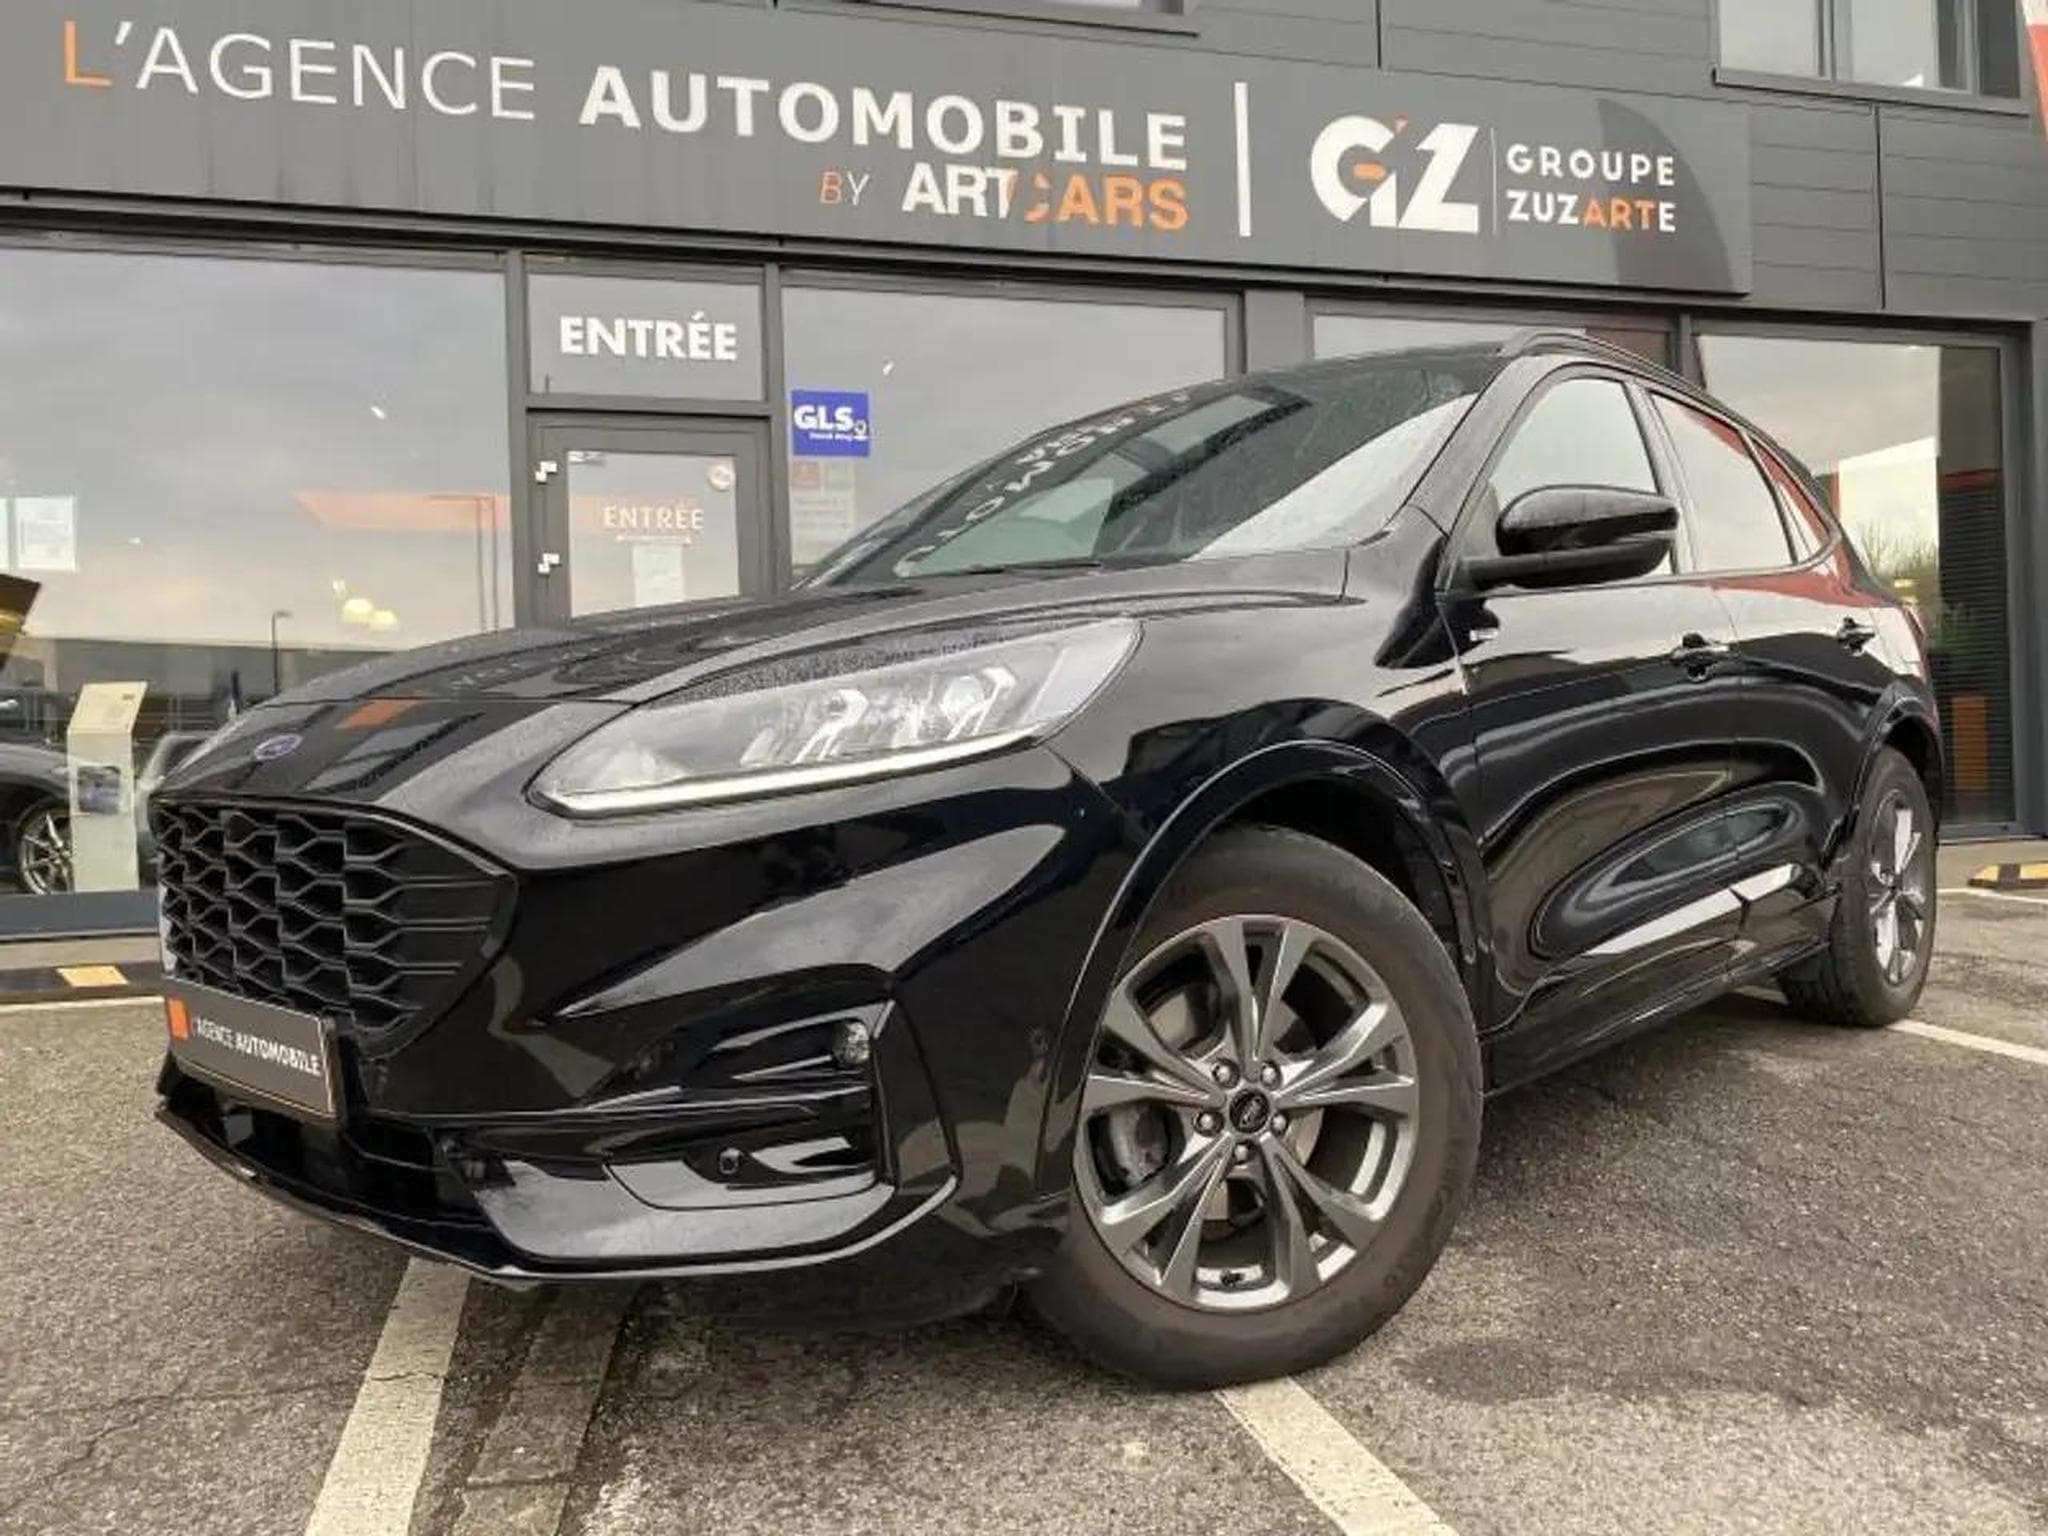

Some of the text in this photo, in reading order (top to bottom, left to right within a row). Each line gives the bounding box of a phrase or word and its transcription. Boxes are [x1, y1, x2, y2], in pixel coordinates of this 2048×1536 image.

[64, 20, 1188, 171] L'AGENCE AUTOMOBILE
[1506, 143, 1675, 186] GROUPE
[819, 170, 870, 206] BY
[1506, 188, 1677, 233] ZUZARTE
[560, 311, 738, 361] ENTRÉE
[793, 404, 854, 432] GLS
[235, 1031, 321, 1078] AUTOMOBILE
